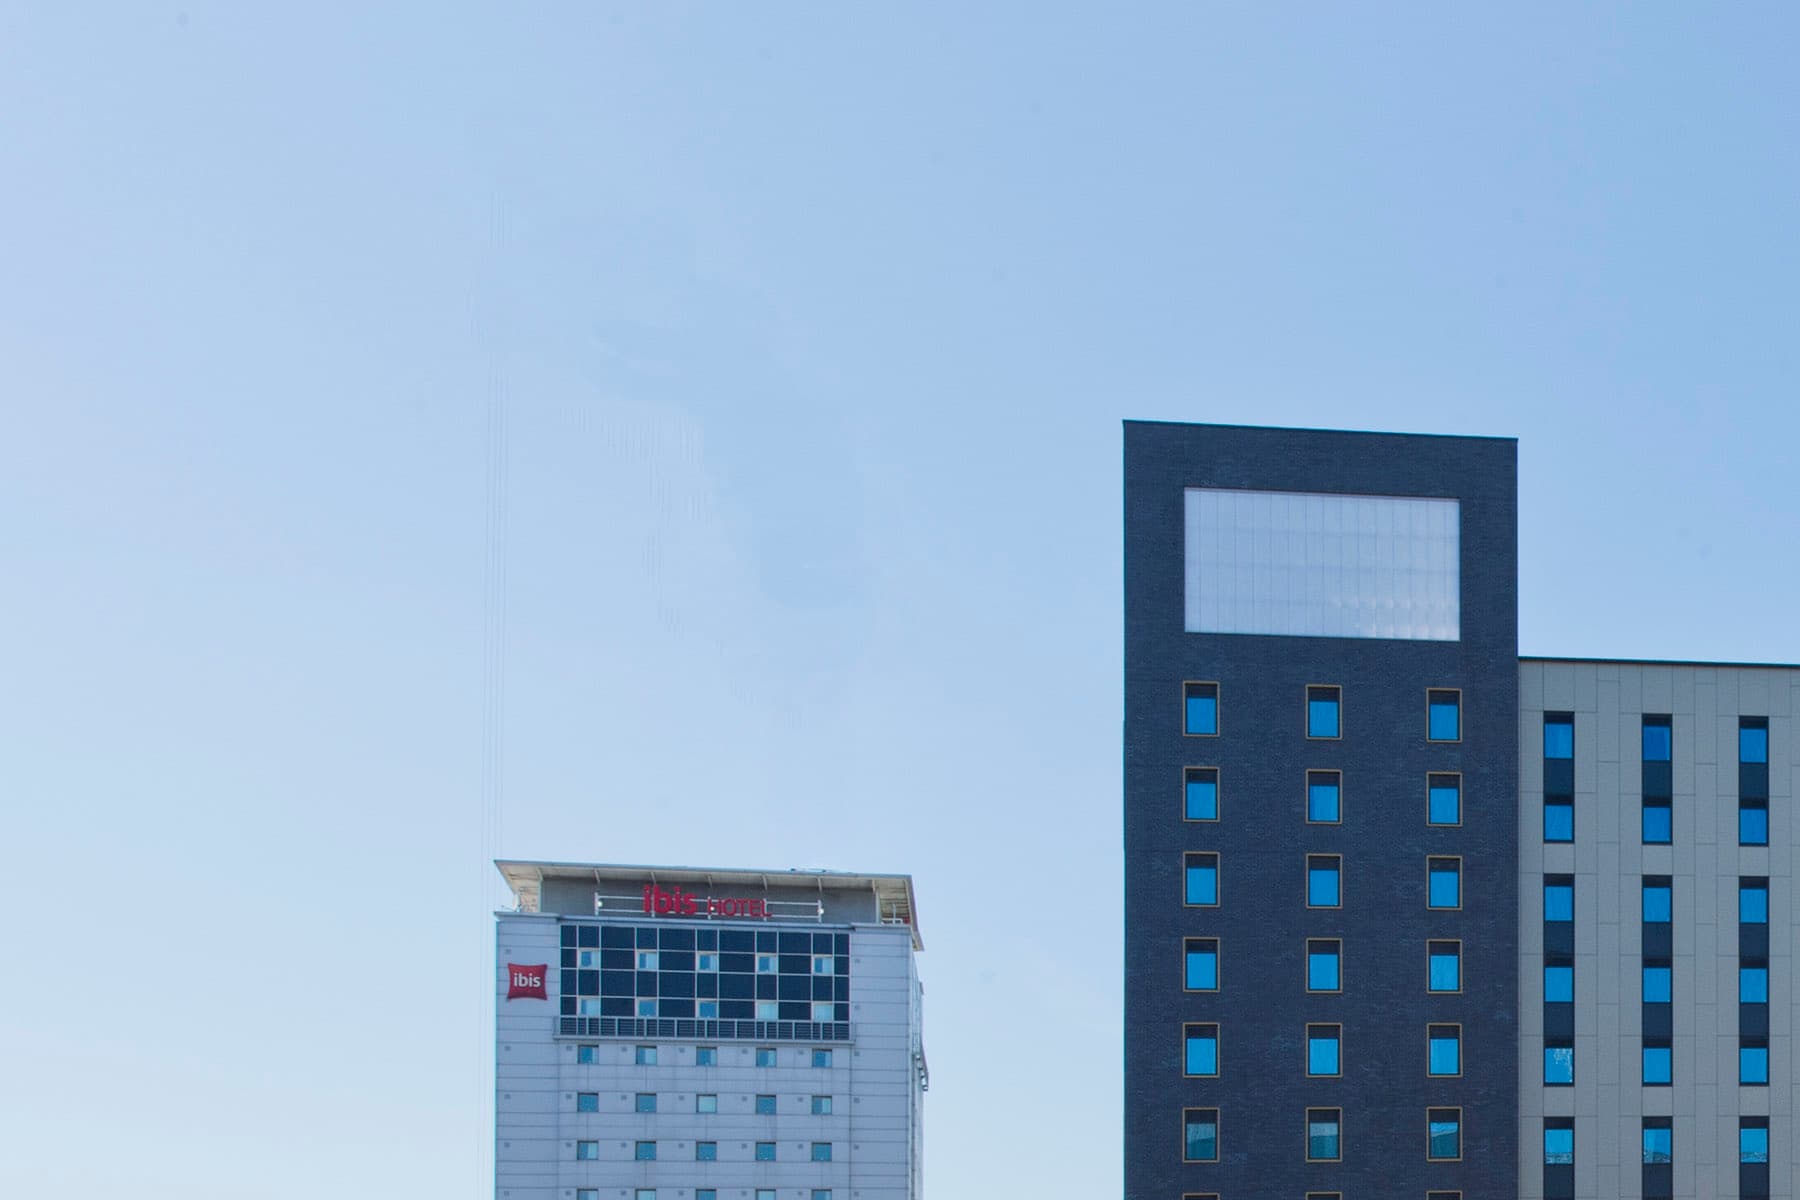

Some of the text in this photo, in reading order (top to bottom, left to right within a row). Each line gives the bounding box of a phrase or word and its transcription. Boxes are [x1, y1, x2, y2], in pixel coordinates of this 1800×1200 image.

[642, 884, 772, 917] ibis HOTEL
[512, 972, 541, 988] ibis
